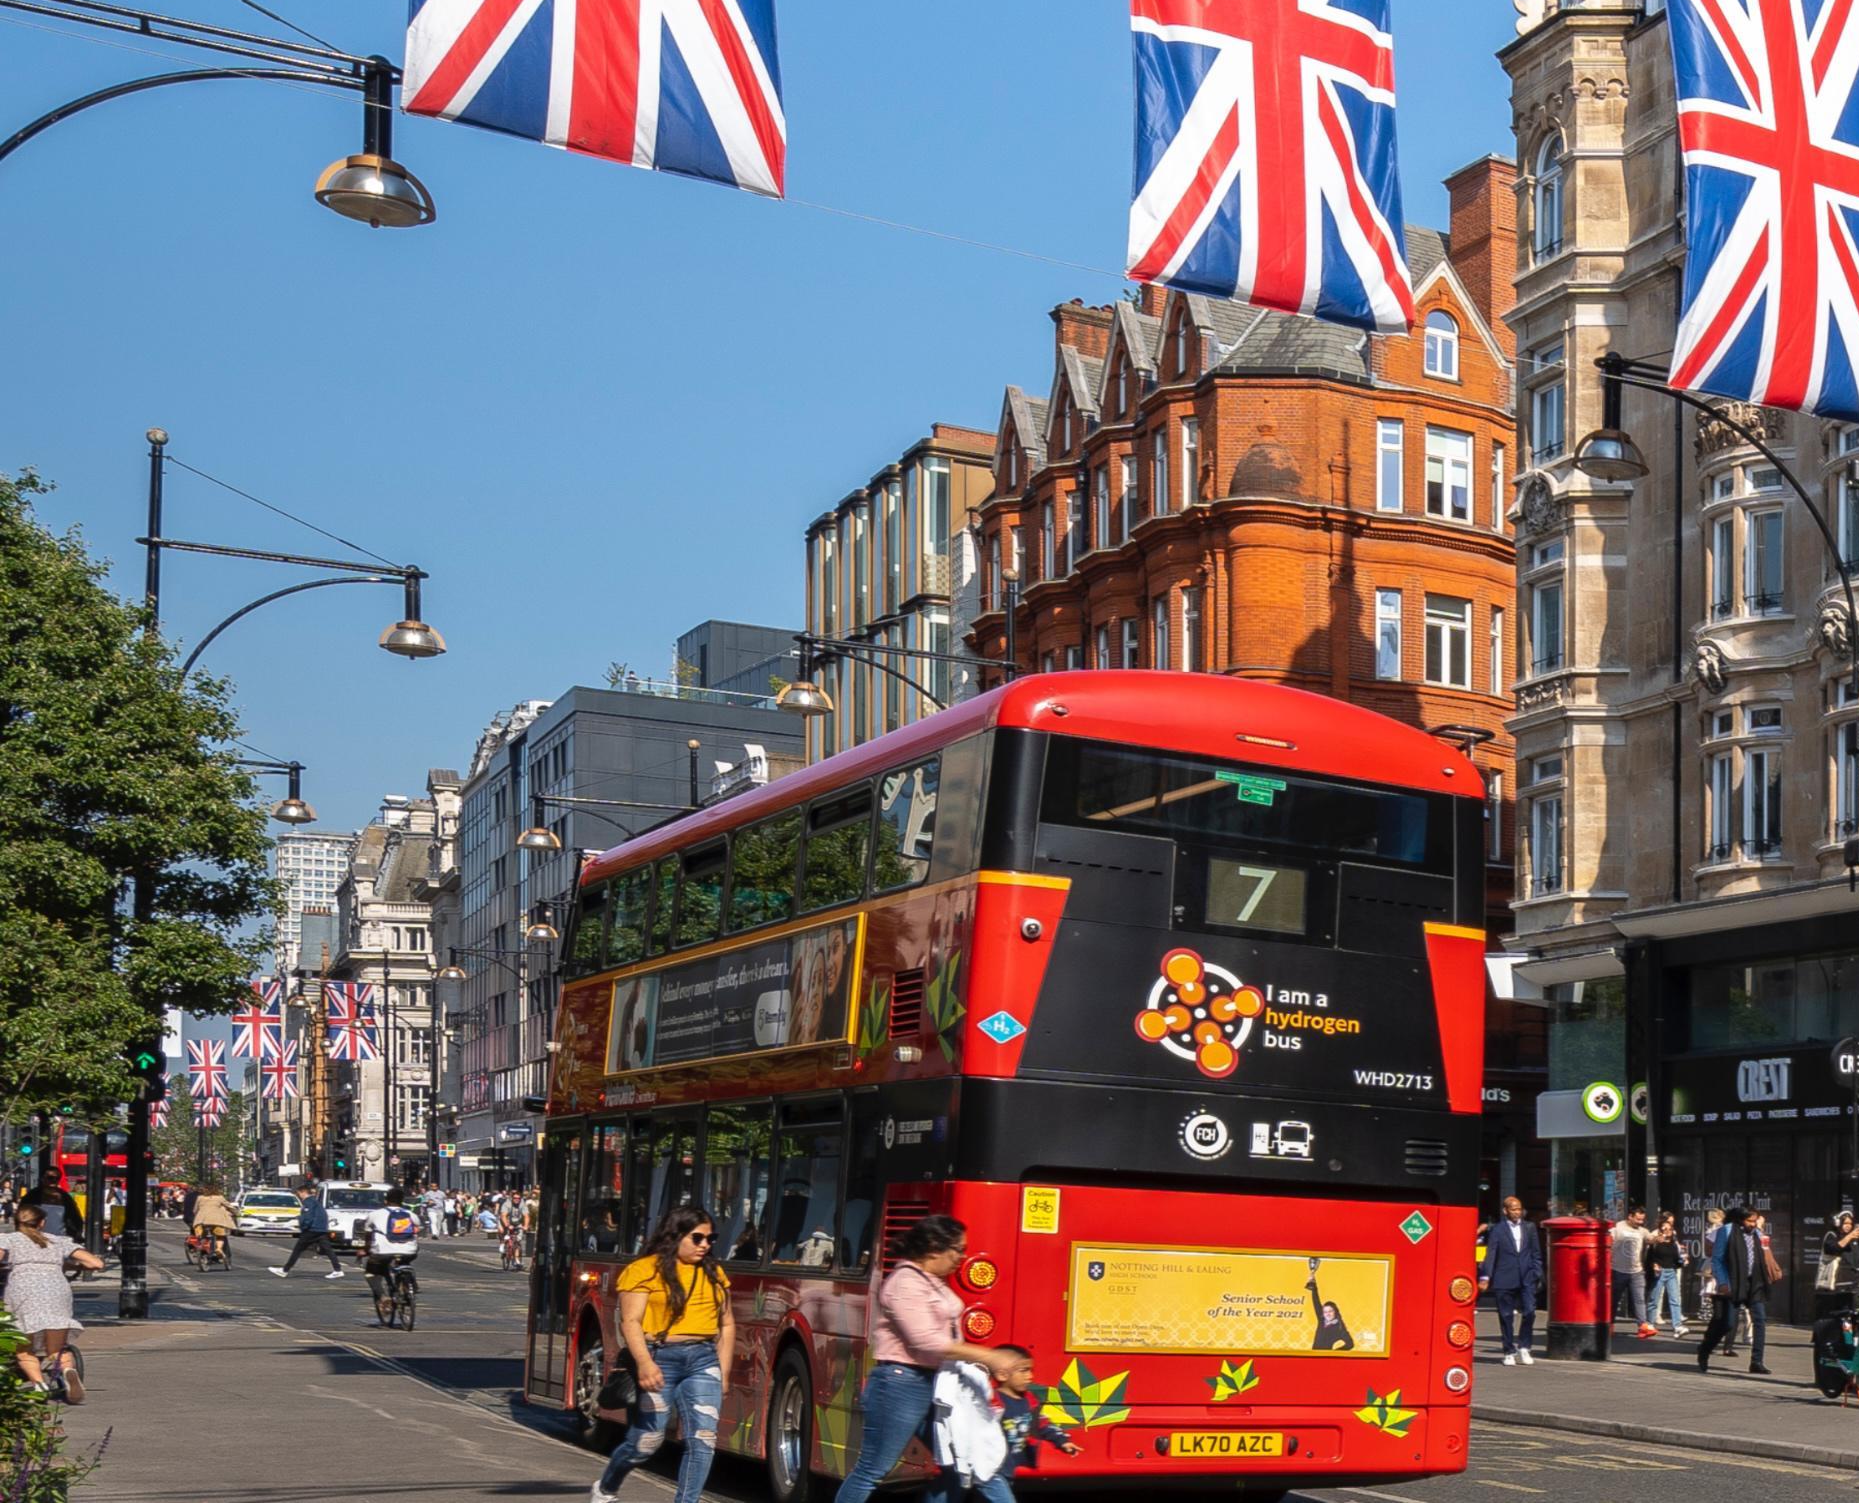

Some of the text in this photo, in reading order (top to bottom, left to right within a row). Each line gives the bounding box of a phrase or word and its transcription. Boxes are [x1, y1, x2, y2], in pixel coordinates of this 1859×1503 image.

[1237, 866, 1278, 922] 7
[1266, 985, 1328, 1008] I am a
[1265, 1007, 1360, 1035] hydrogen
[1264, 1030, 1302, 1050] bus
[1354, 1069, 1434, 1091] WHD2713
[1737, 1057, 1792, 1103] CREST
[1480, 1087, 1511, 1103] ld's
[1196, 1127, 1217, 1141] FCH
[1110, 1262, 1159, 1272] NOTTING
[1161, 1263, 1184, 1273] HILL
[1196, 1265, 1232, 1275] EALING
[1221, 1293, 1305, 1305] Senior School
[1207, 1306, 1304, 1319] of the Year 2021
[1179, 1434, 1273, 1453] LK70 AZC
